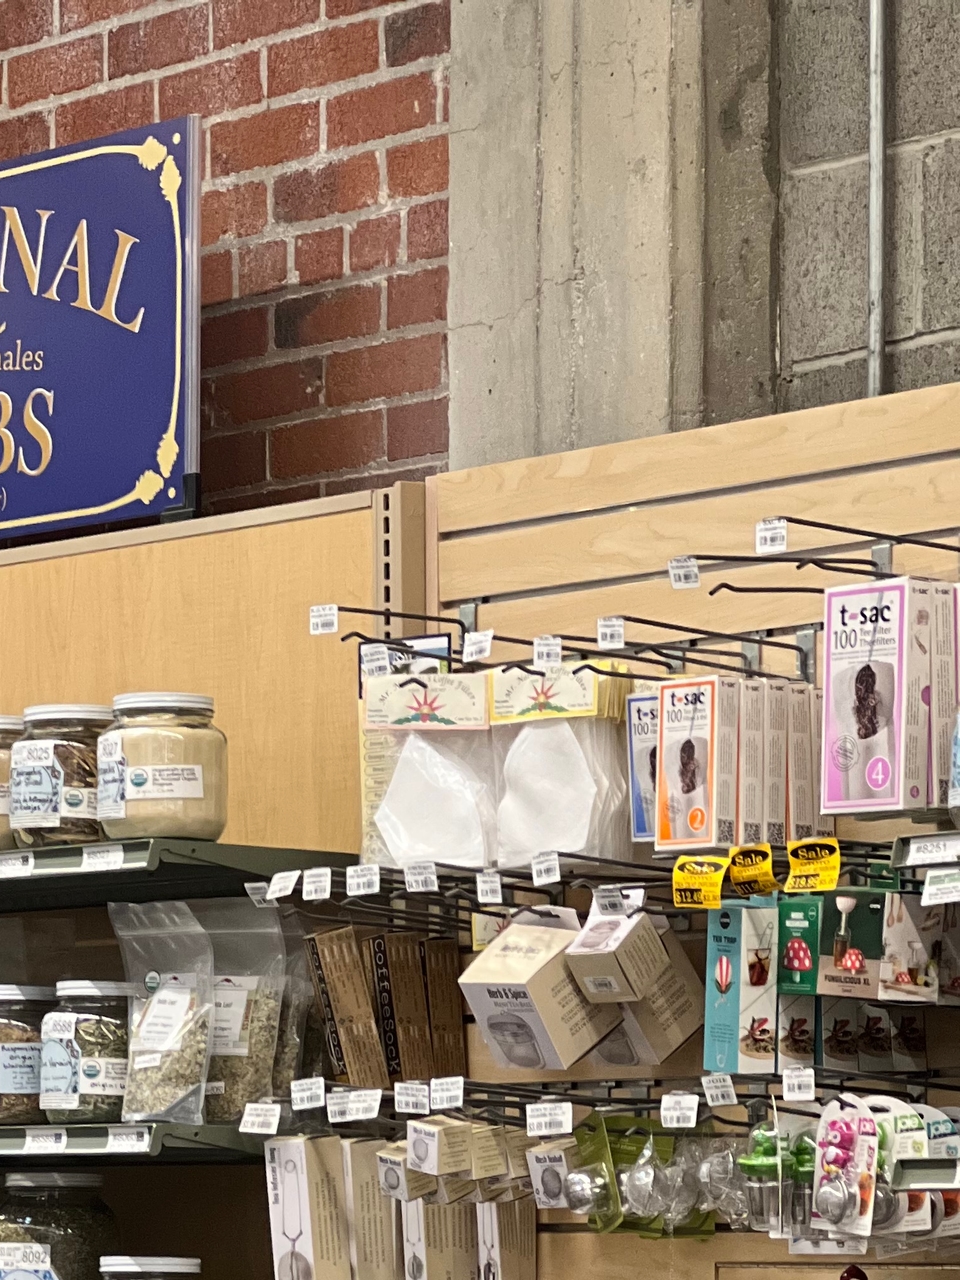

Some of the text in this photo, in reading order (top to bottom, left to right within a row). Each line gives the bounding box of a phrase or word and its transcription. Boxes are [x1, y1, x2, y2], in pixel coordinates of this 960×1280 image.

[840, 603, 891, 626] t-sac
[834, 629, 857, 649] 100
[670, 691, 705, 706] t-sac
[667, 709, 682, 722] 100
[634, 723, 648, 735] 100
[872, 762, 884, 784] 4
[693, 812, 701, 828] 2
[735, 854, 762, 867] Sale
[798, 848, 829, 859] Sale
[487, 988, 504, 999] Herb
[511, 989, 528, 1001] Spice
[374, 938, 400, 1070] CoffeeSock
[22, 1251, 48, 1264] 8092
